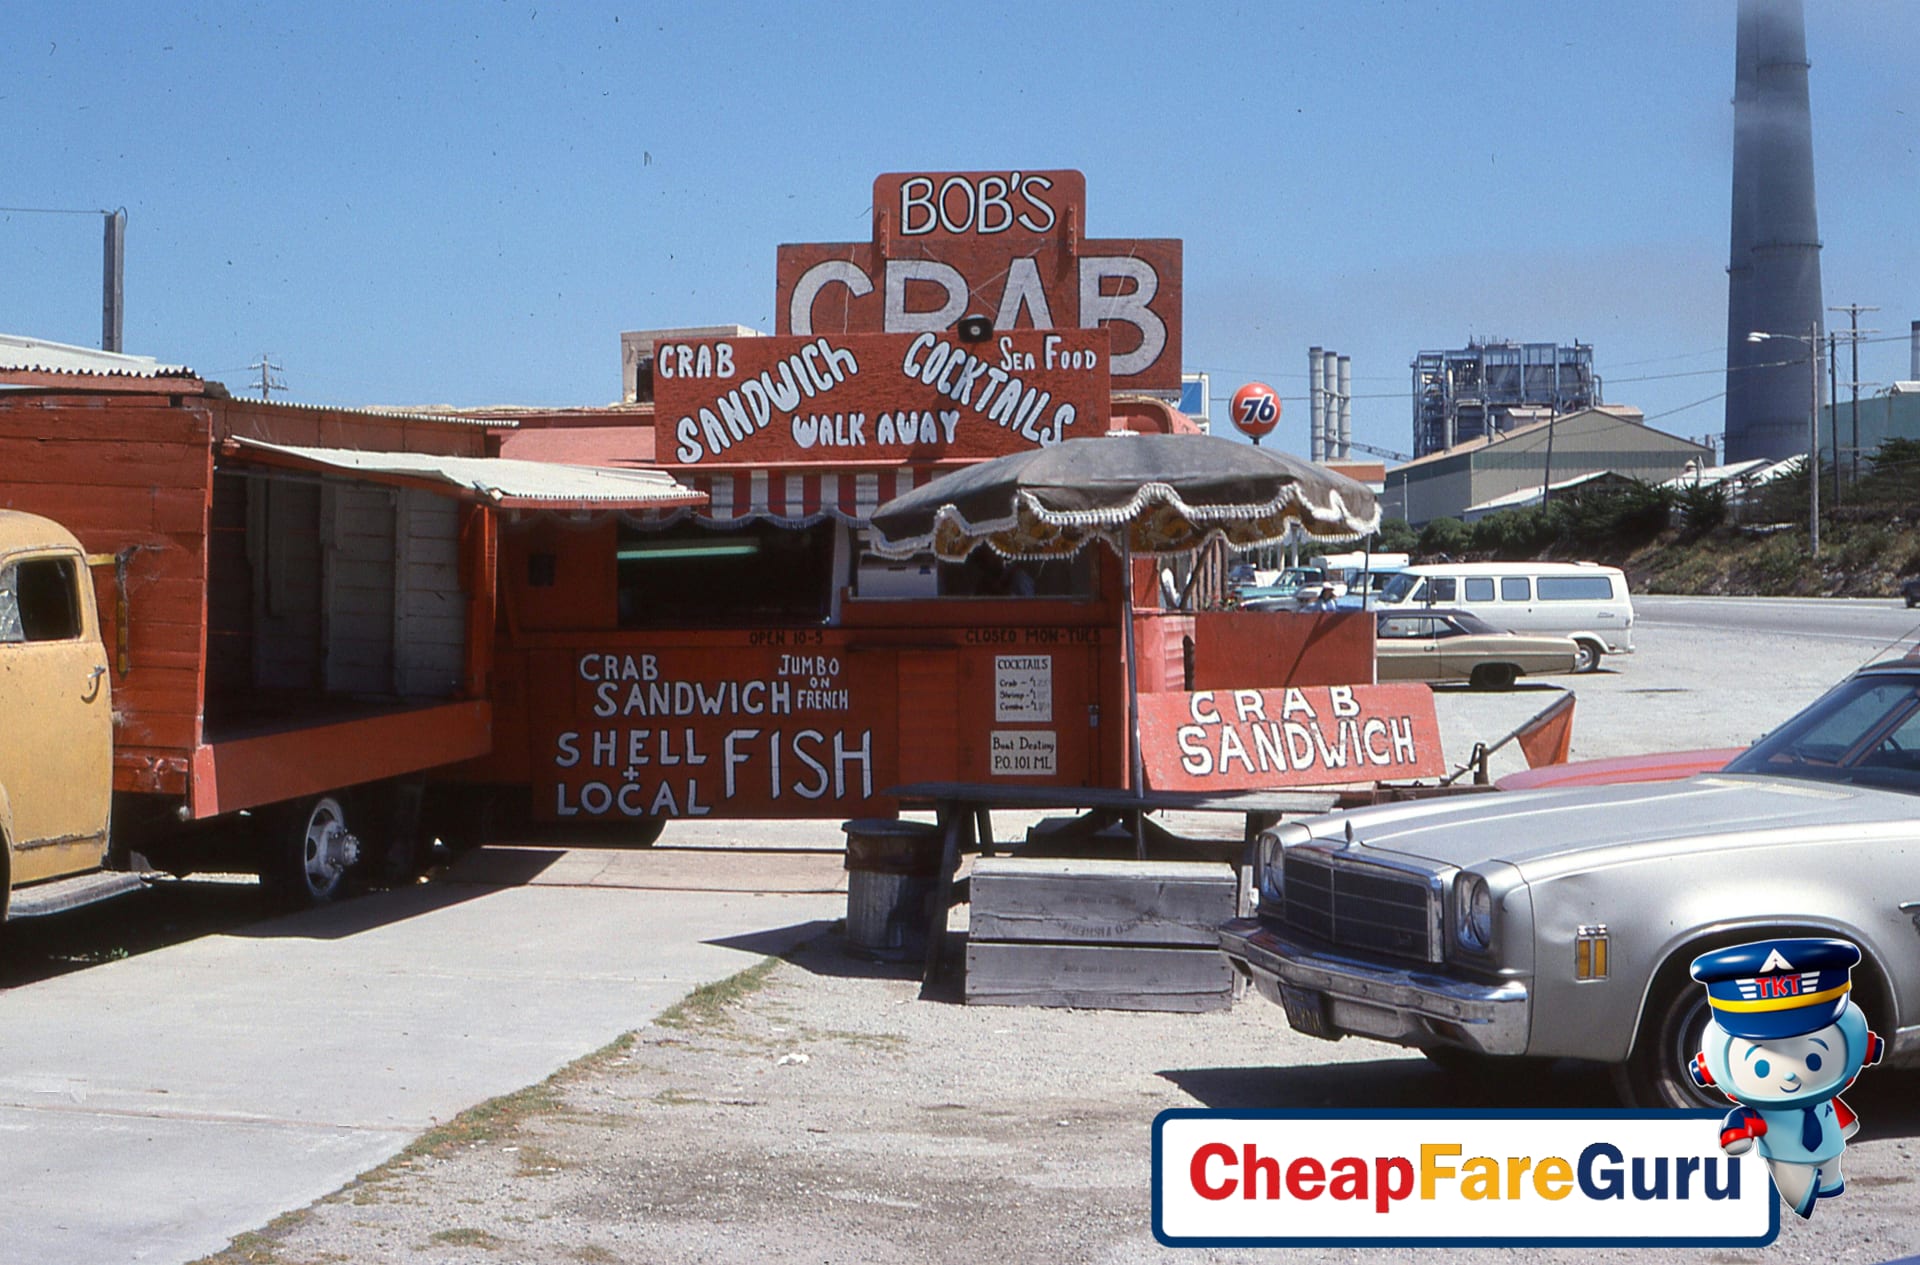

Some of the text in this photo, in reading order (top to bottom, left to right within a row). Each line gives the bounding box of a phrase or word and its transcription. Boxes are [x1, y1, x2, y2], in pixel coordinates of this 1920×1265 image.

[900, 171, 1056, 235] BOB'S
[789, 254, 1168, 376] CRAB
[658, 342, 736, 379] CRAB
[902, 331, 1077, 448] COCKTAILS
[1240, 393, 1277, 424] 76
[791, 409, 961, 449] WALK AWAY
[750, 631, 824, 646] OPEN 10-5
[965, 629, 1017, 643] CLOSED
[579, 653, 659, 681] CRAB
[778, 654, 840, 676] JUMBO
[810, 677, 831, 689] ON
[998, 659, 1049, 670] COCKTAILS
[593, 680, 791, 718] SANDWICH
[797, 689, 849, 710] FRENCH
[1189, 684, 1361, 725] CRAB
[555, 728, 873, 800] SHELL FISH
[1177, 716, 1417, 776] SANDWICH
[556, 778, 712, 817] LOCAL
